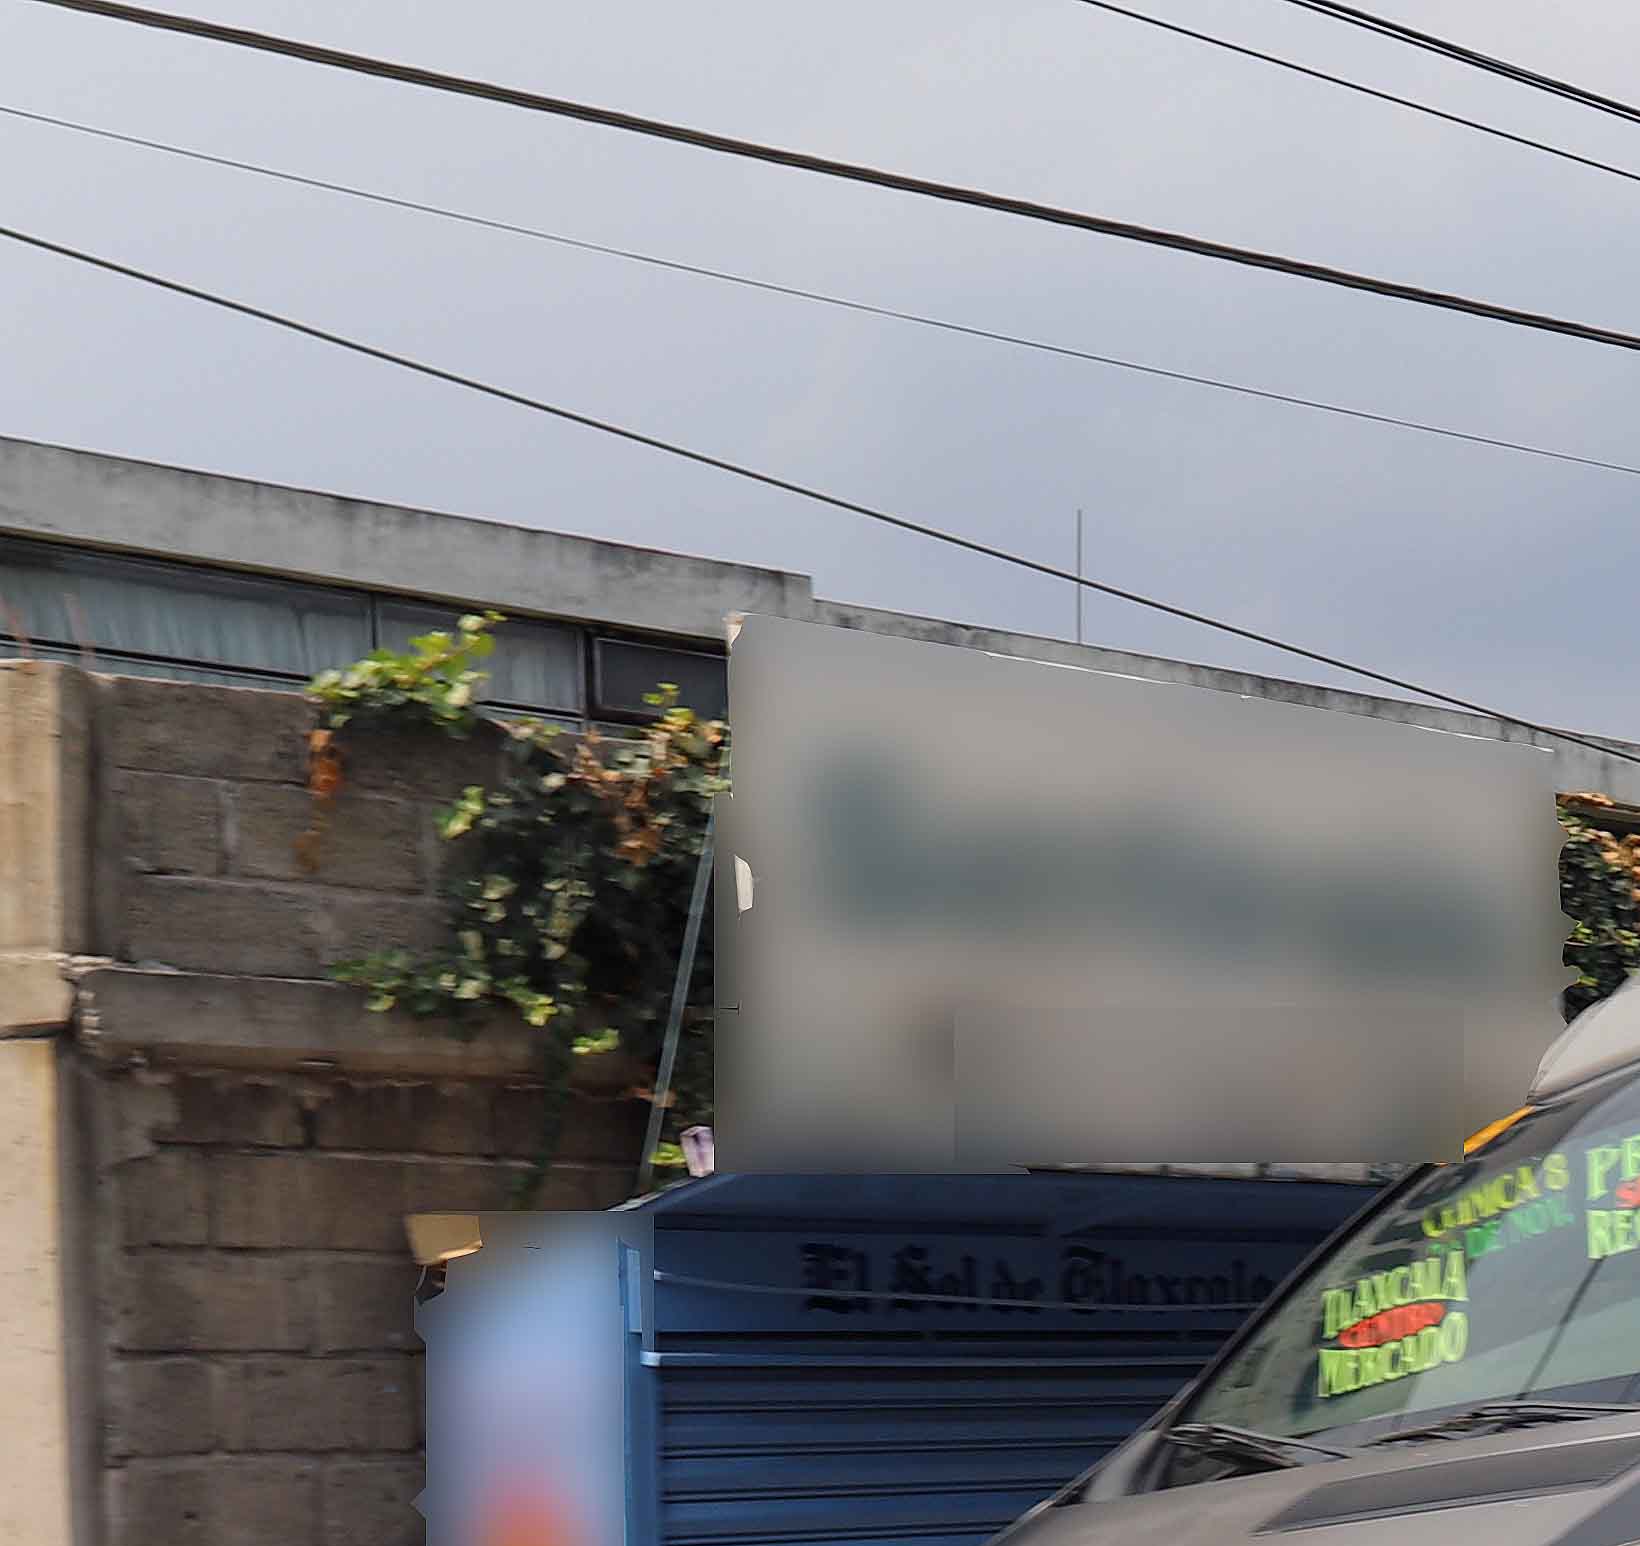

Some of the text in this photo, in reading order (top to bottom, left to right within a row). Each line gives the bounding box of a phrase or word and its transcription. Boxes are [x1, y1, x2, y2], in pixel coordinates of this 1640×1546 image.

[797, 1241, 870, 1314] El
[893, 1243, 977, 1313] Sol
[991, 1258, 1047, 1315] de
[1320, 1249, 1470, 1339] TLAXCALA
[1317, 1311, 1469, 1398] MERCADO
